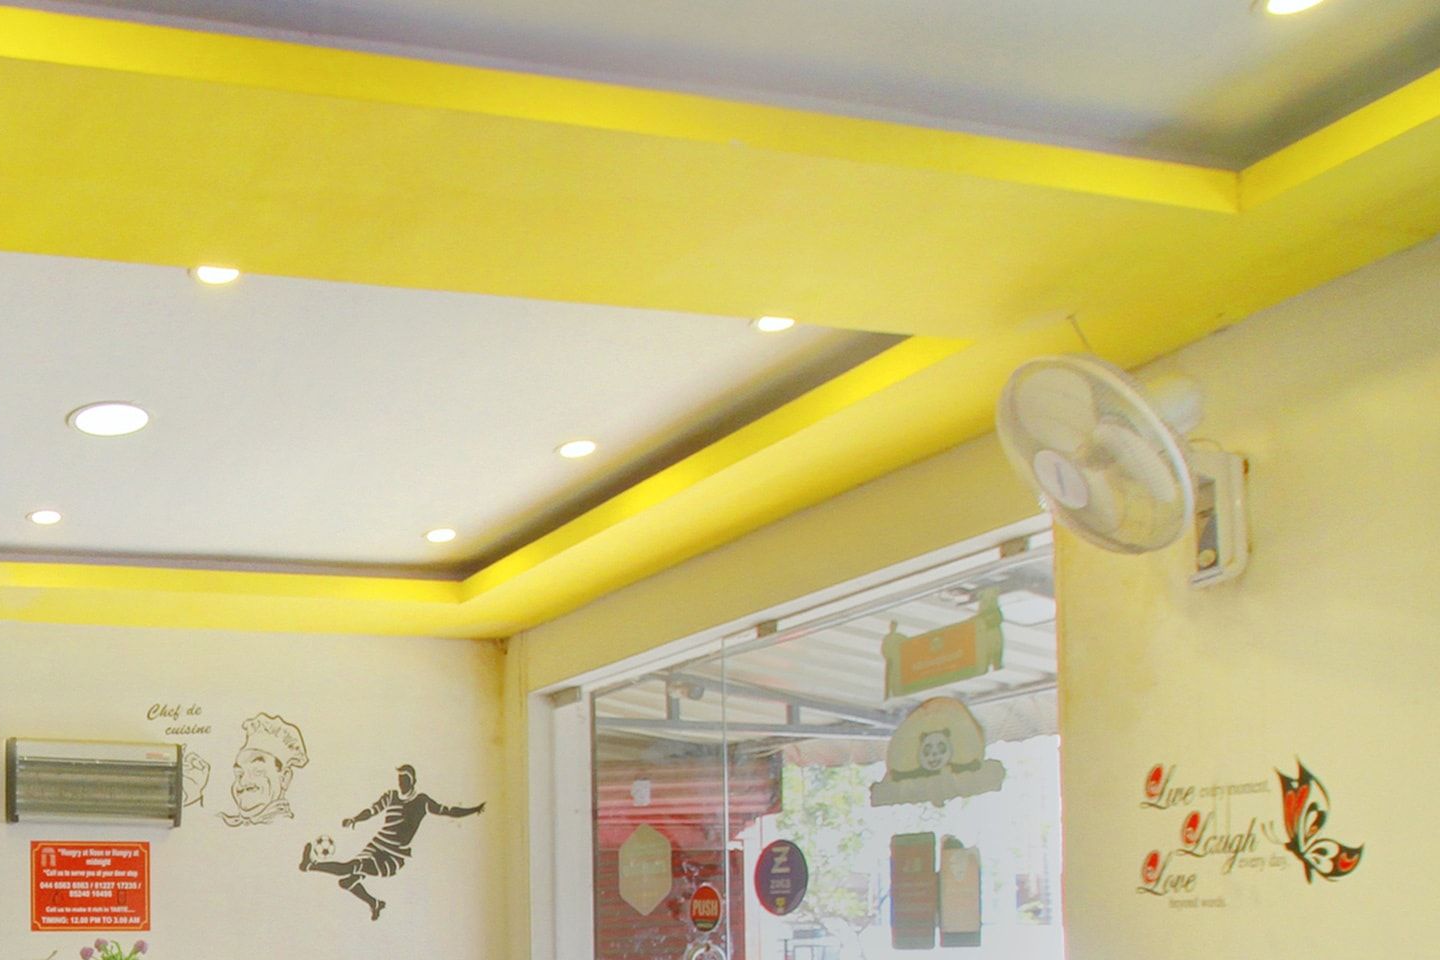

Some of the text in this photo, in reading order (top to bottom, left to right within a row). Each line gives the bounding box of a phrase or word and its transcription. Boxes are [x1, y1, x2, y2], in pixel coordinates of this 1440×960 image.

[146, 703, 202, 721] Chef de
[165, 724, 212, 735] cuisine
[1176, 810, 1257, 876] Laugh
[1135, 851, 1197, 896] Love
[692, 899, 719, 917] PUSH
